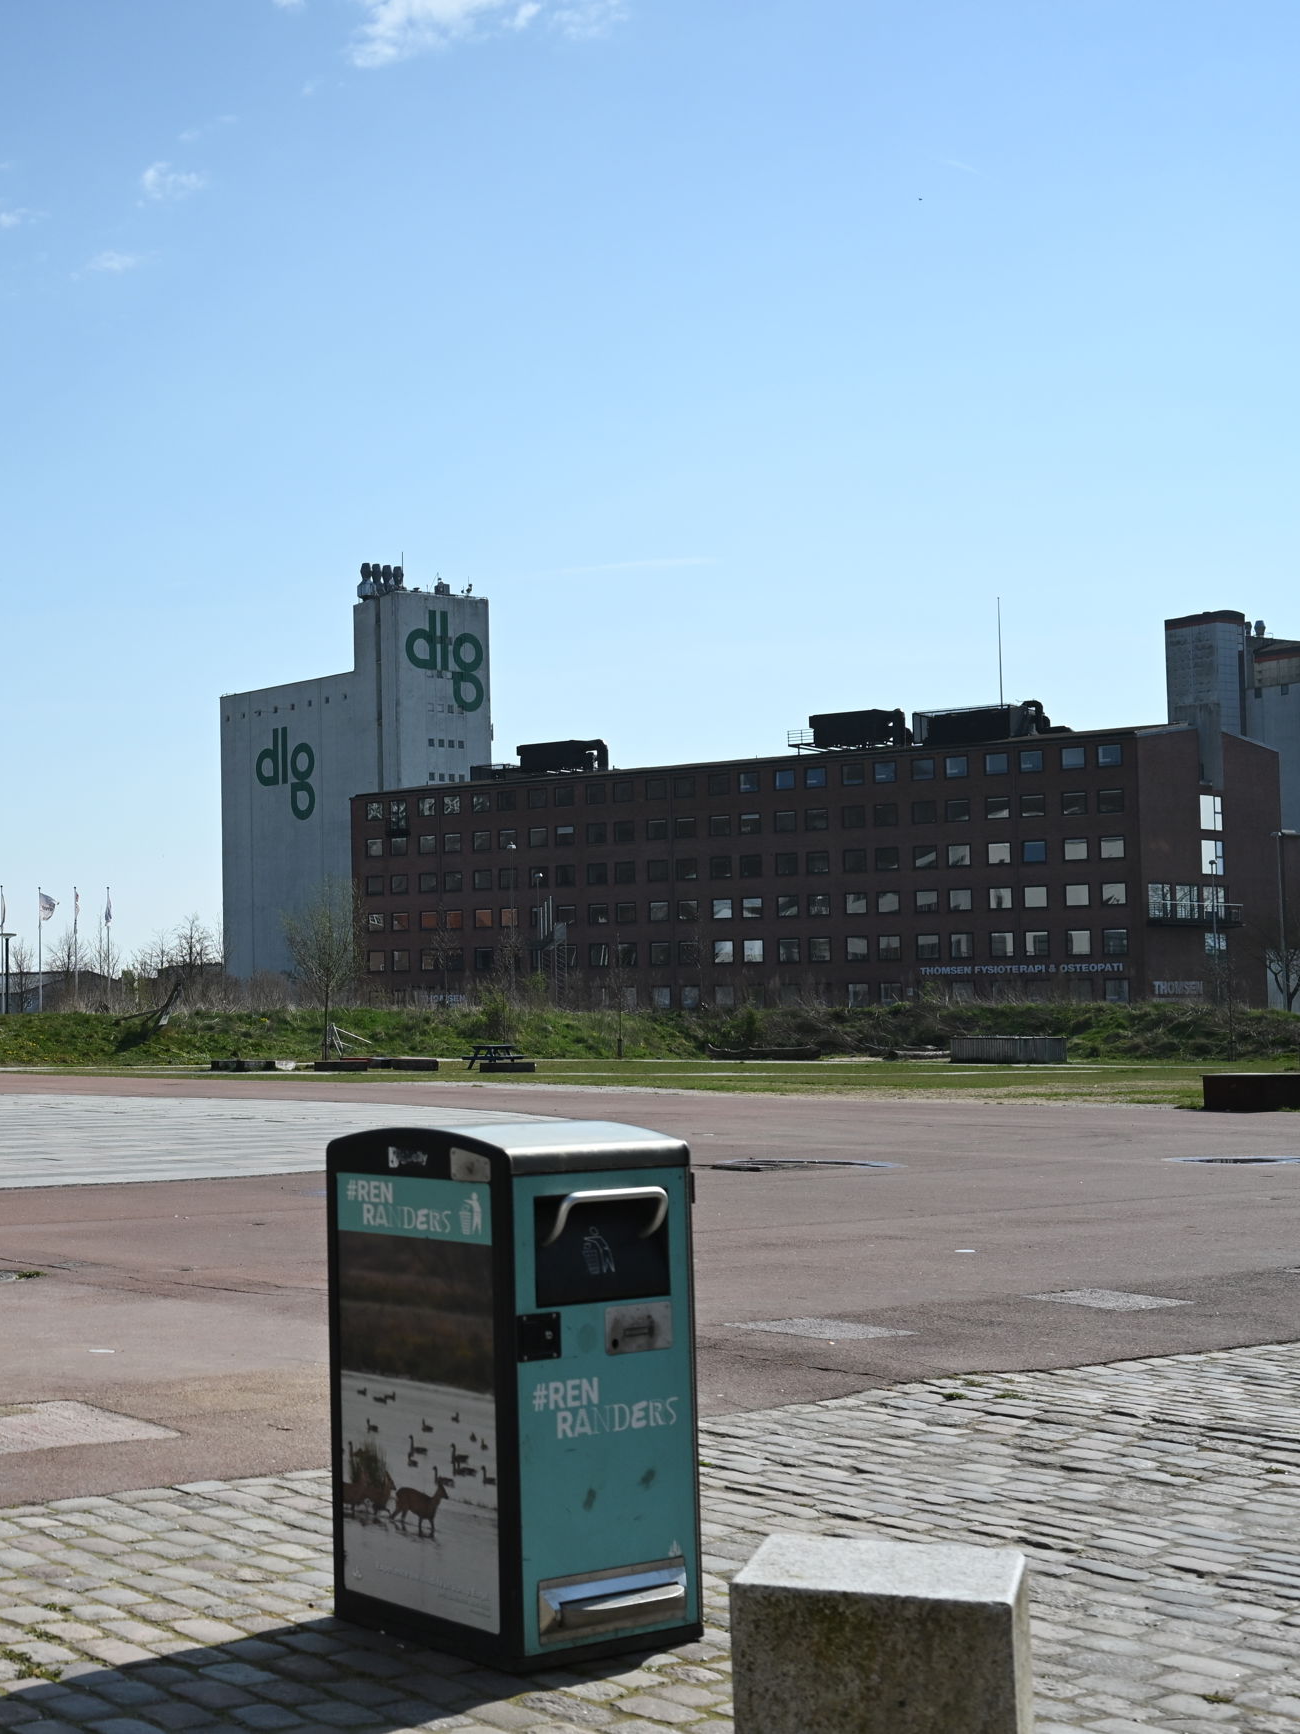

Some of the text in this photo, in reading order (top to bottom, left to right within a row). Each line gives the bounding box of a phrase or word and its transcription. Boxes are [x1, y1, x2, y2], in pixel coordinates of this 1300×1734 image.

[405, 609, 484, 712] dlg
[255, 726, 316, 821] dlg
[920, 963, 1124, 976] THOMSEN FYSIOTERAPI & OSTEOPATI
[1153, 980, 1204, 995] THOMSEN
[346, 1179, 394, 1204] #REN
[362, 1203, 451, 1233] RANDERS
[532, 1376, 599, 1412] #REN
[556, 1396, 679, 1440] RANDERS
